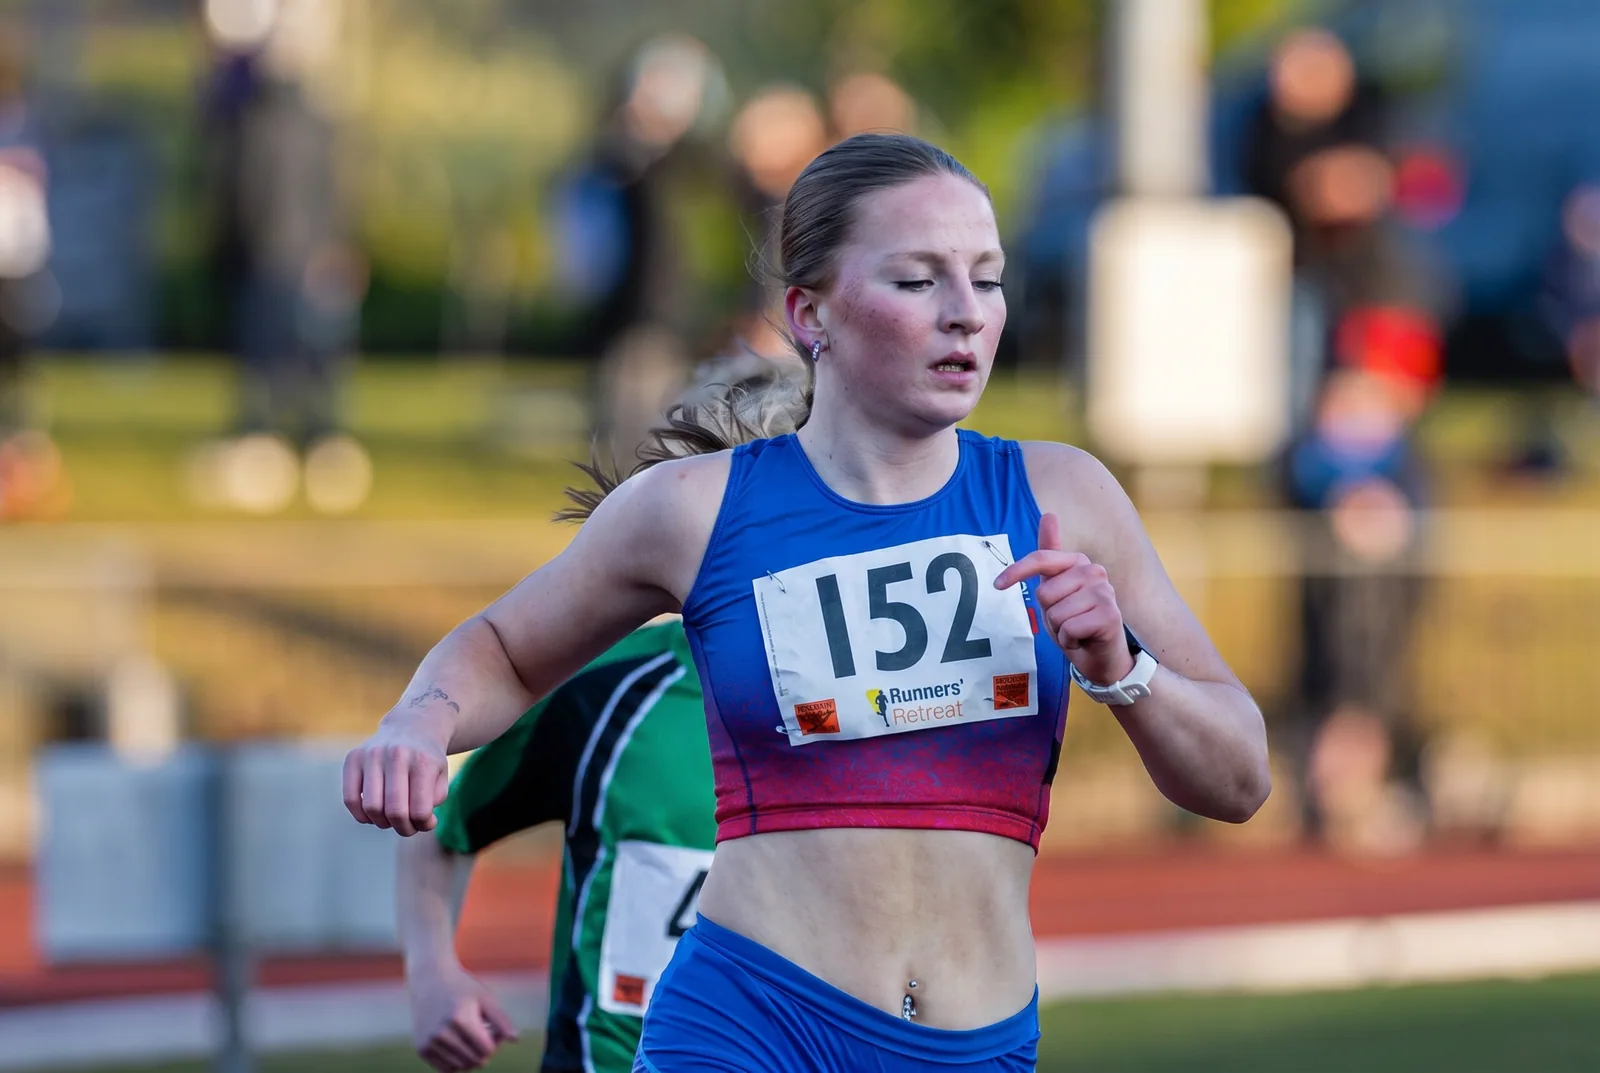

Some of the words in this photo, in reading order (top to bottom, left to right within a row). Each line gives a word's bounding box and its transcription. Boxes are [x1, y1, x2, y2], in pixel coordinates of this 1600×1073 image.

[815, 552, 993, 679] 152
[889, 678, 964, 704] Runners'
[892, 700, 964, 725] Retreat
